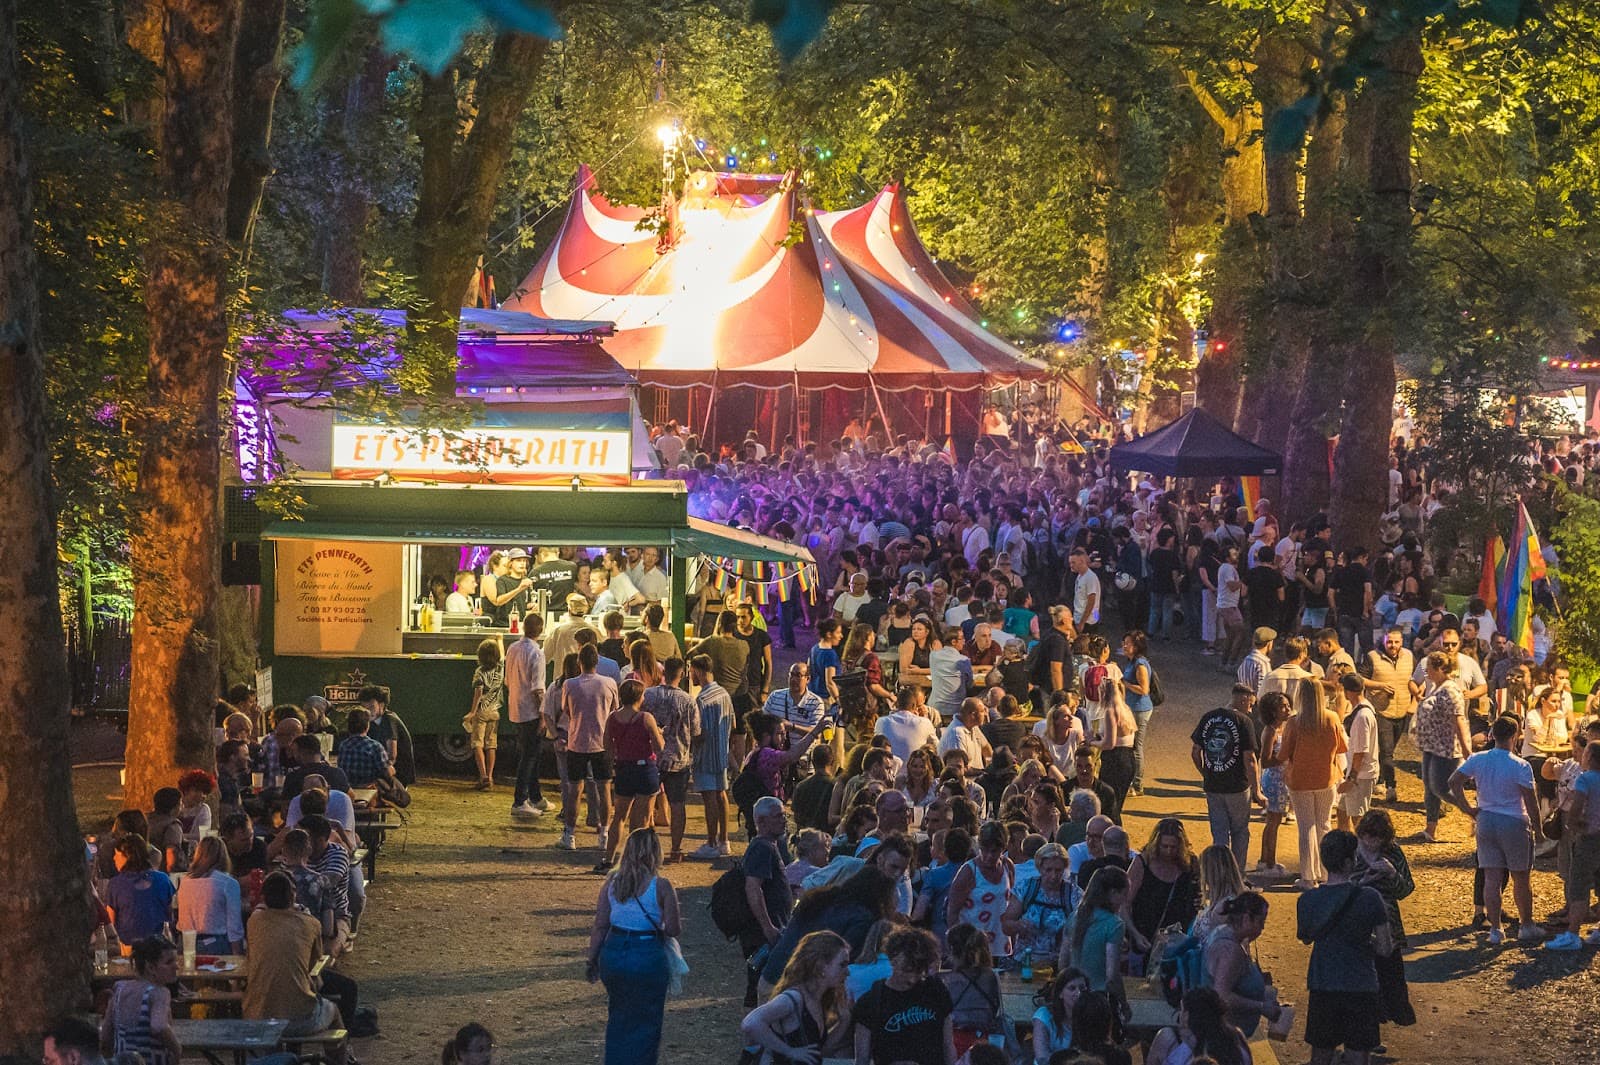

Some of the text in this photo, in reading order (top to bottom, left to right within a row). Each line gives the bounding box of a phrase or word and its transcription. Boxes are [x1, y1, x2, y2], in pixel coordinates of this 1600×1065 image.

[352, 434, 407, 461] ETS
[296, 549, 373, 575] ETS PENNERATH
[328, 581, 340, 591] du
